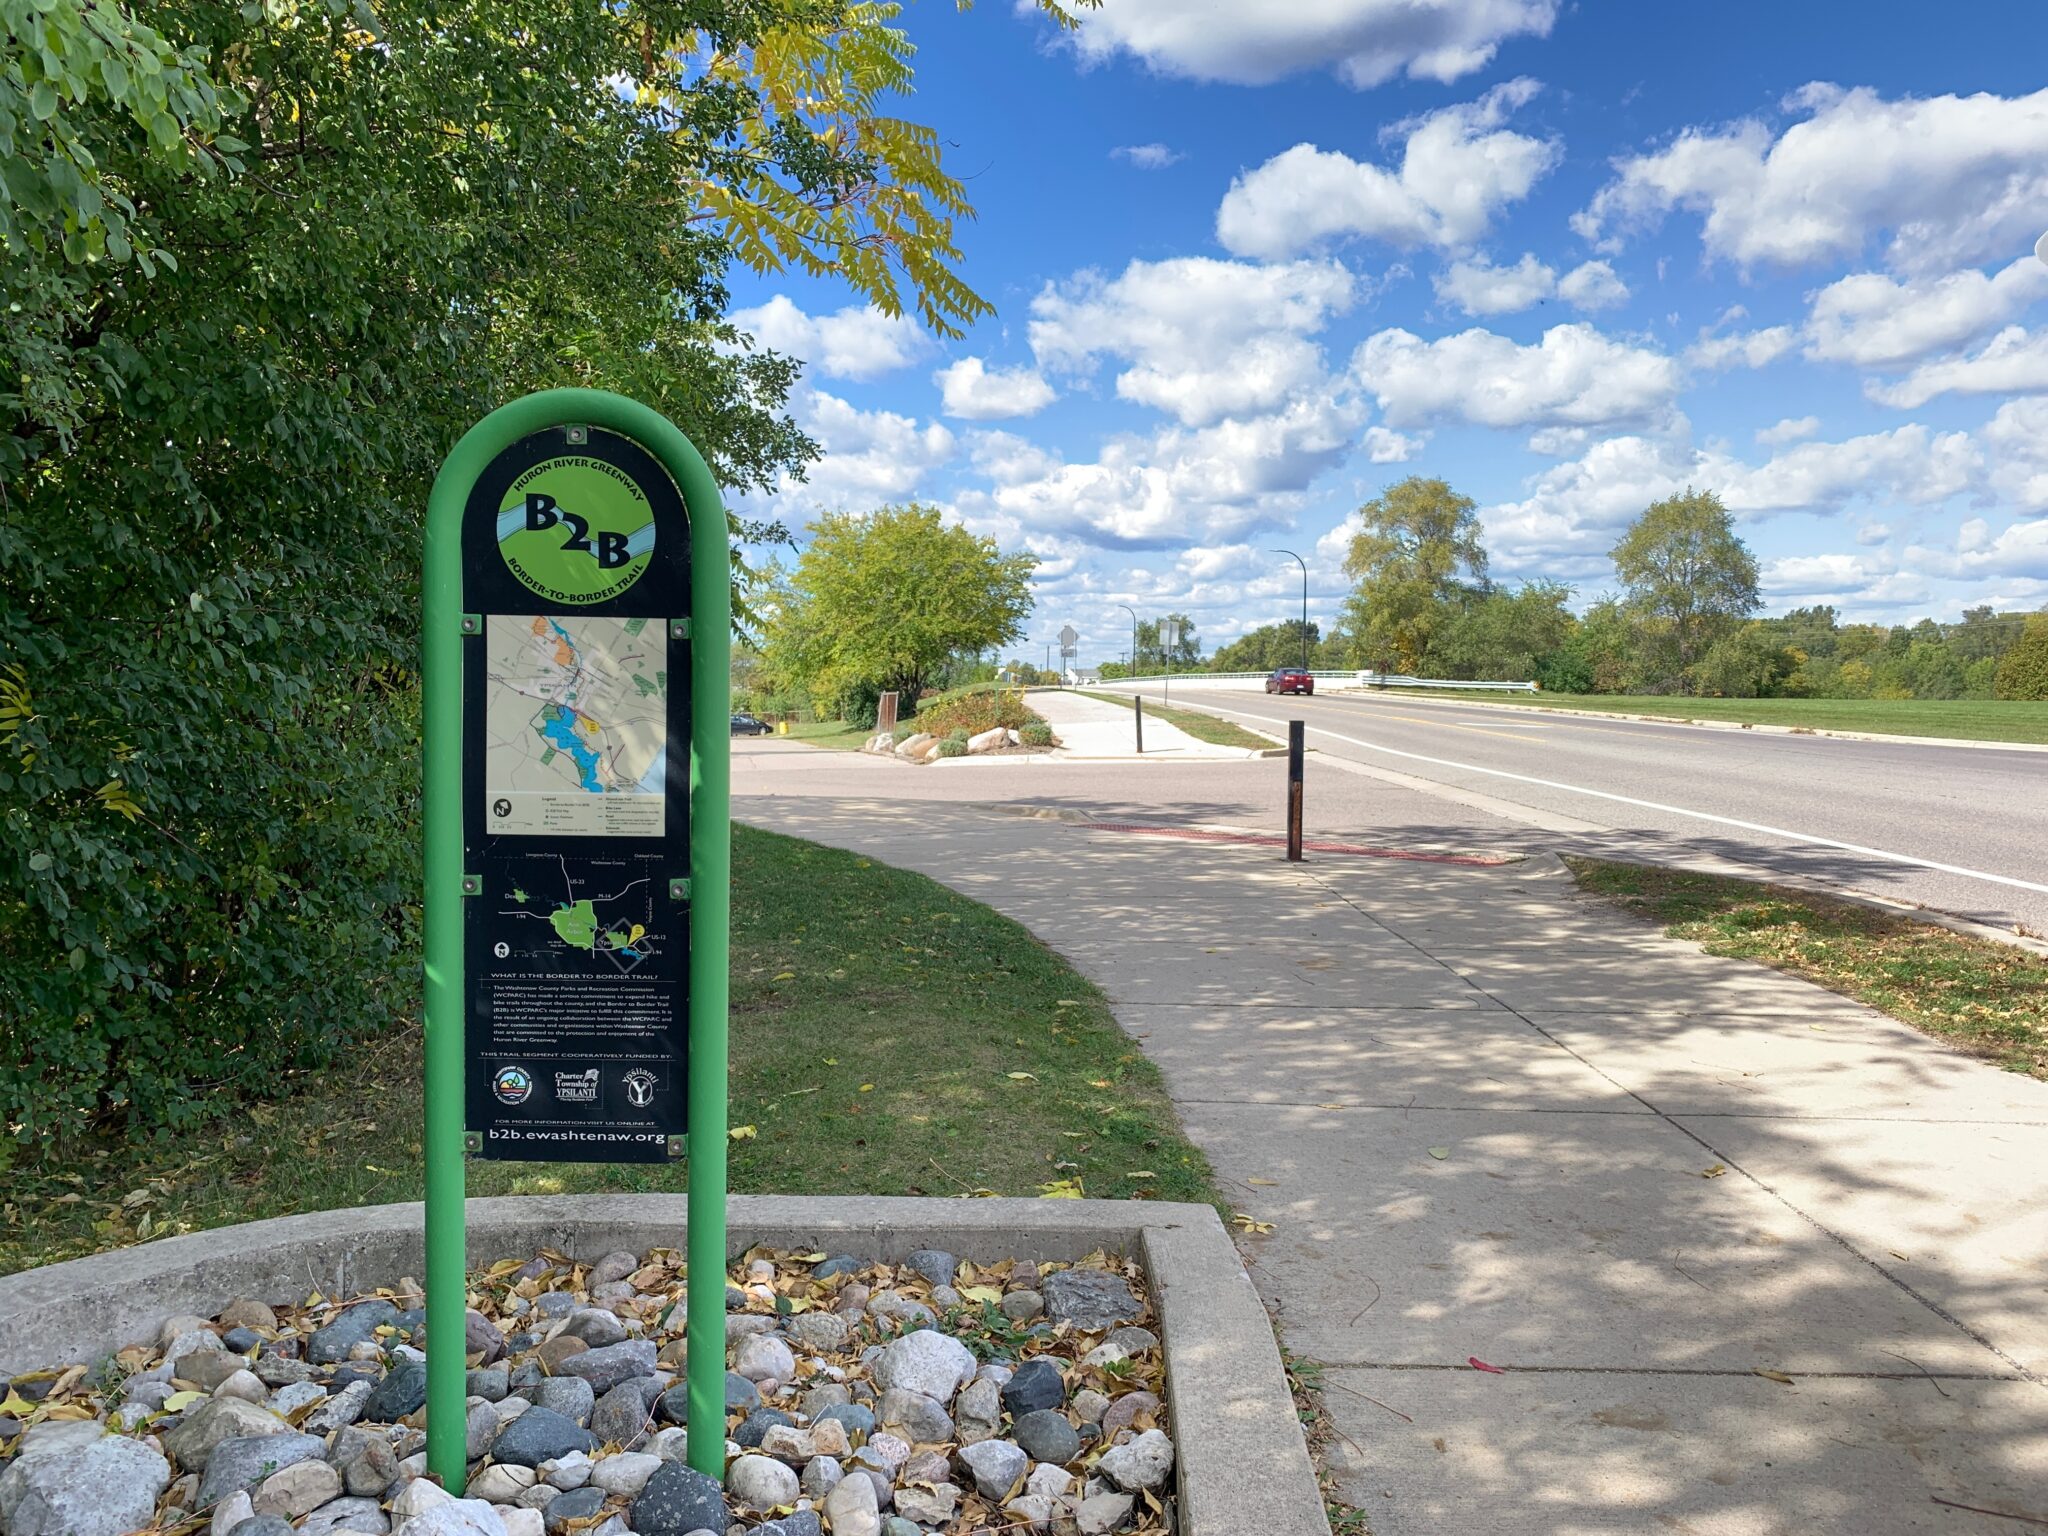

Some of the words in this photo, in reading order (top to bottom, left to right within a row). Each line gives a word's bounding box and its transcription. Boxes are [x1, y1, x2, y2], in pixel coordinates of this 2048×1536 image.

[514, 462, 552, 491] HURON
[554, 459, 588, 468] RIVER
[591, 462, 644, 502] GREENWAY
[526, 493, 631, 568] B2B
[508, 558, 616, 602] BORDER-TO-BORDER
[616, 564, 643, 590] TRAIL
[622, 1068, 659, 1083] Ypsilanti
[555, 1079, 589, 1088] Township
[591, 1081, 598, 1089] of
[557, 1088, 595, 1096] YPSILANTI
[489, 1129, 665, 1144] b2b.ewashtenaw.org
